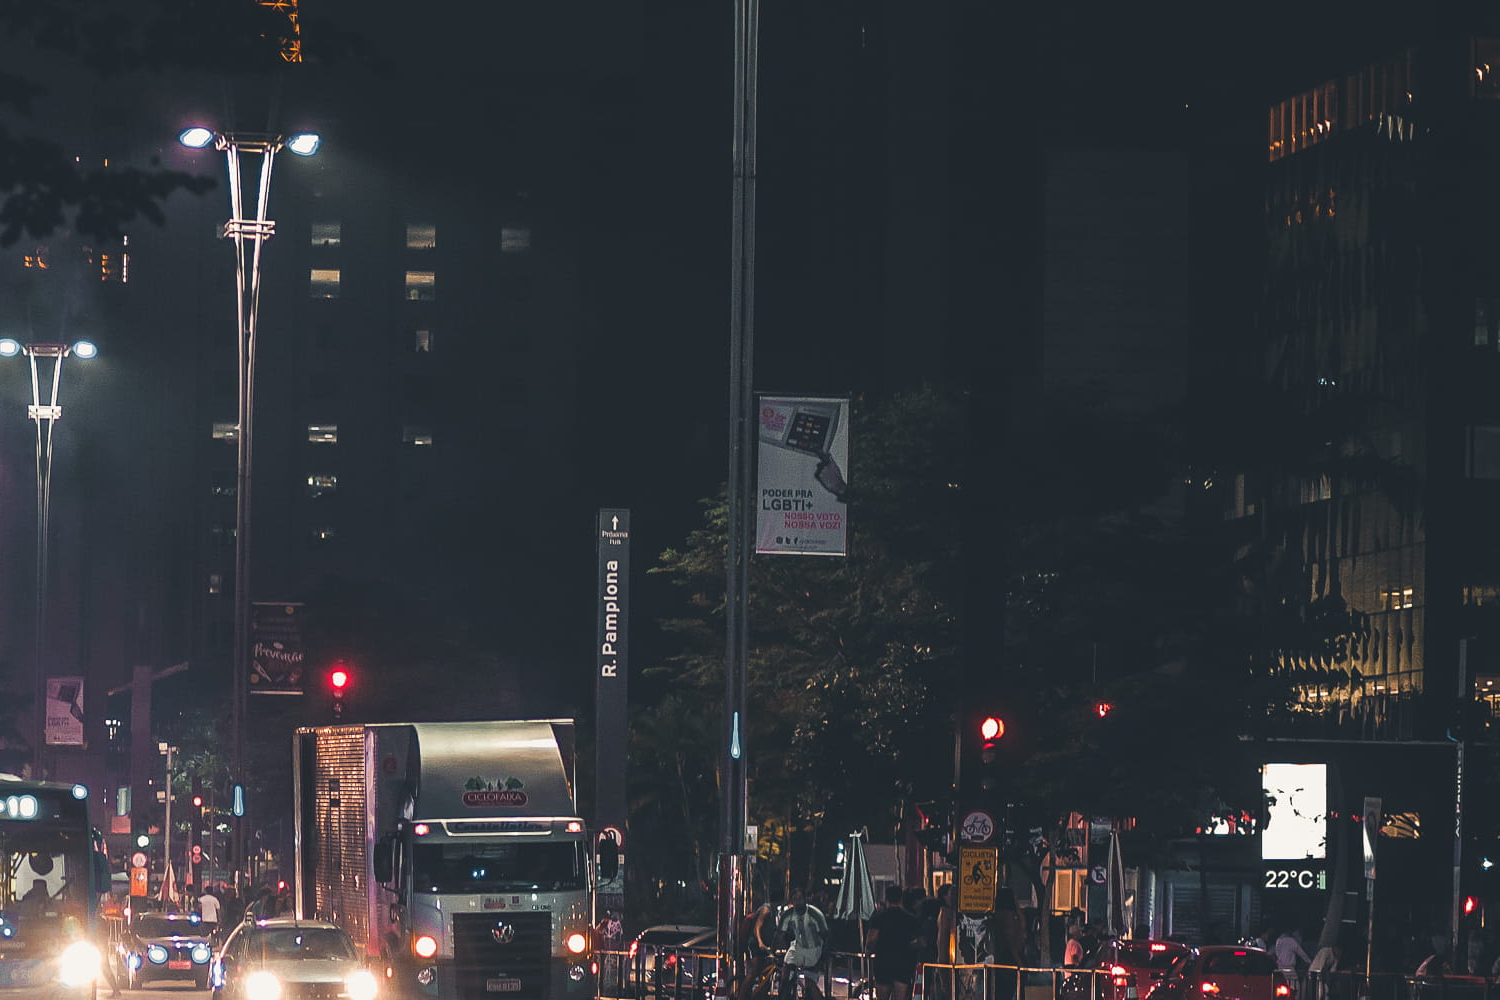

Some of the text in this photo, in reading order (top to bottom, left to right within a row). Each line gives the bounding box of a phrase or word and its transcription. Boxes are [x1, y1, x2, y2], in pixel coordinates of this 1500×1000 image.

[762, 489, 813, 498] PODER PRA
[762, 499, 813, 511] LGBTI+
[601, 560, 620, 677] R. Pamplona
[467, 793, 522, 801] CICLOFAIXA
[1265, 870, 1313, 889] 22°C
